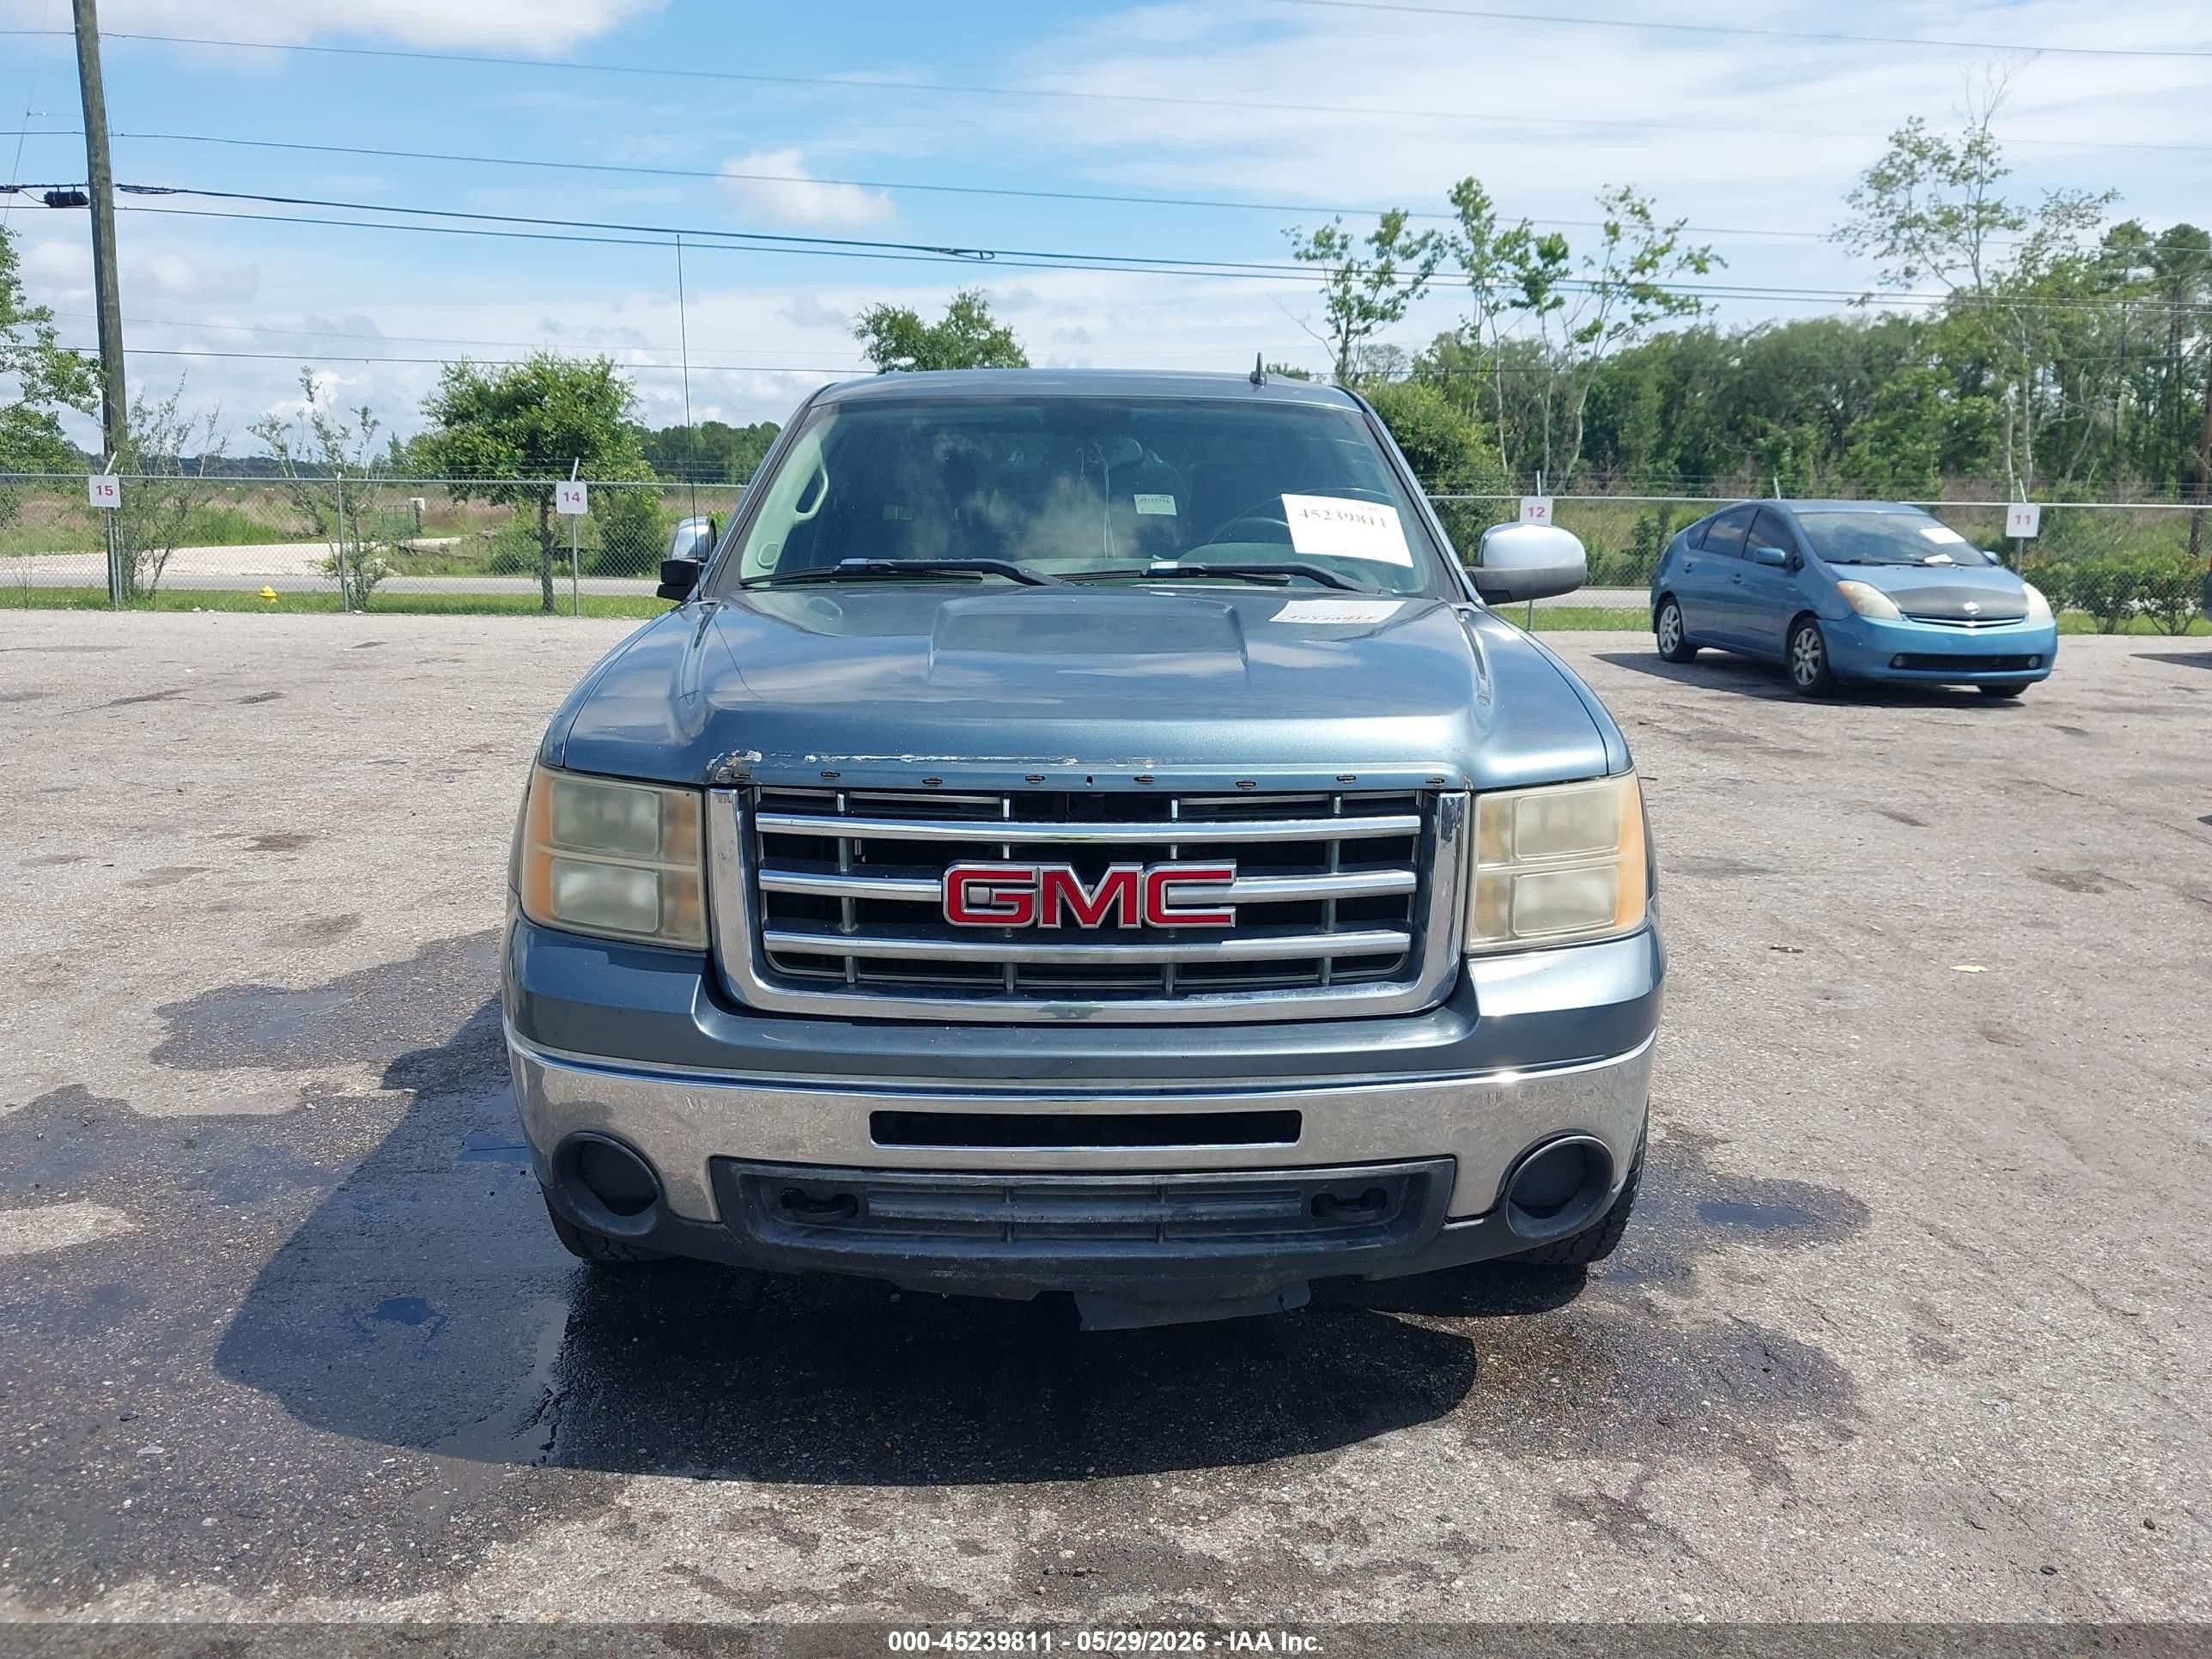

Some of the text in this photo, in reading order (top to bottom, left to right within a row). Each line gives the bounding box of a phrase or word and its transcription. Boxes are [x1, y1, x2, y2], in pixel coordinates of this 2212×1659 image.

[95, 484, 114, 496] 15
[562, 491, 581, 503] 14
[1527, 507, 1546, 518] 12
[2014, 514, 2032, 526] 11
[942, 860, 1237, 929] GMC
